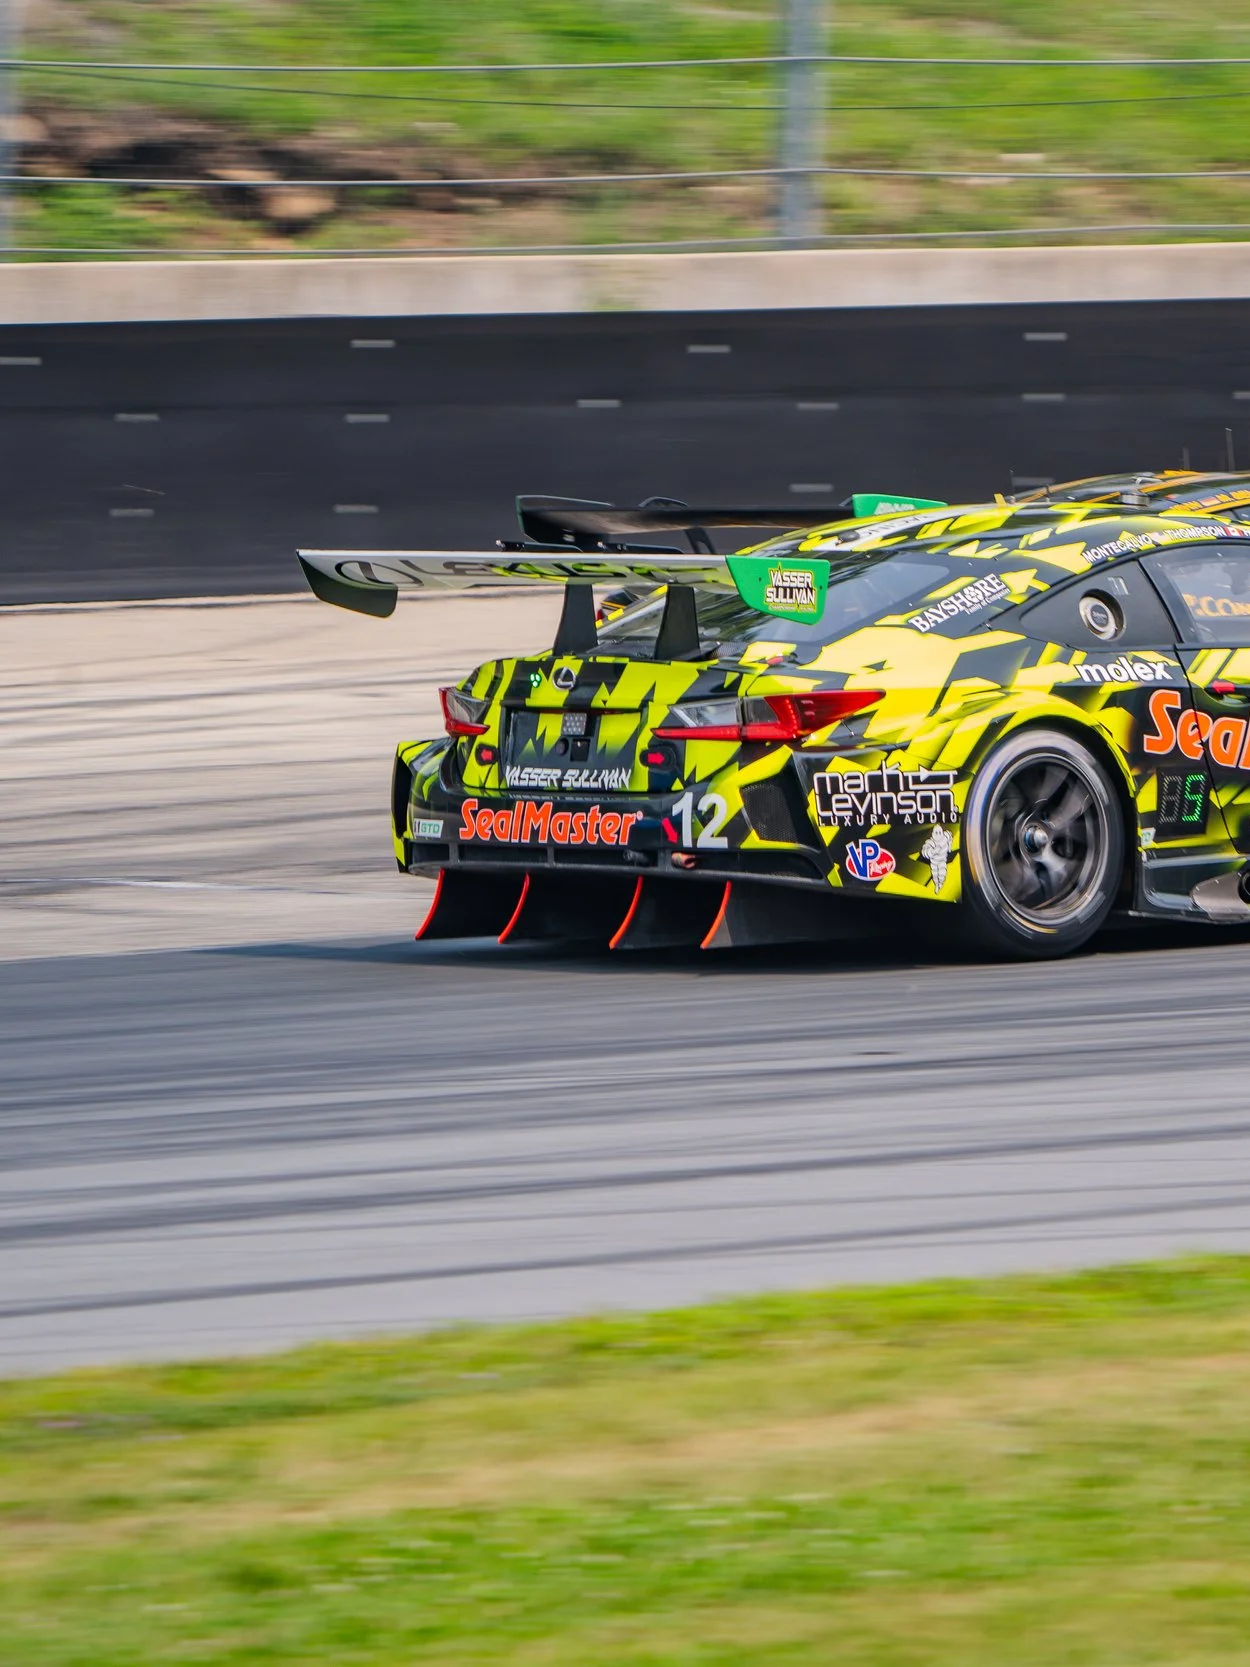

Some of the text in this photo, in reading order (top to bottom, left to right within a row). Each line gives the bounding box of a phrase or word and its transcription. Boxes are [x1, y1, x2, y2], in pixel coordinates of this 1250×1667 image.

[1082, 533, 1152, 564] MONTECALVO
[1164, 525, 1226, 541] THOMPSON
[770, 567, 813, 588] VASSER
[766, 587, 815, 605] SULLIVAN
[909, 573, 1006, 633] BAYSHORE
[1075, 656, 1173, 683] molex
[505, 765, 632, 790] VASSER SULLIVAN
[420, 822, 441, 834] GTD
[459, 798, 638, 845] SealMaster
[672, 791, 728, 849] 12
[818, 811, 958, 827] LUXURY AUDIO
[846, 839, 881, 879] VP
